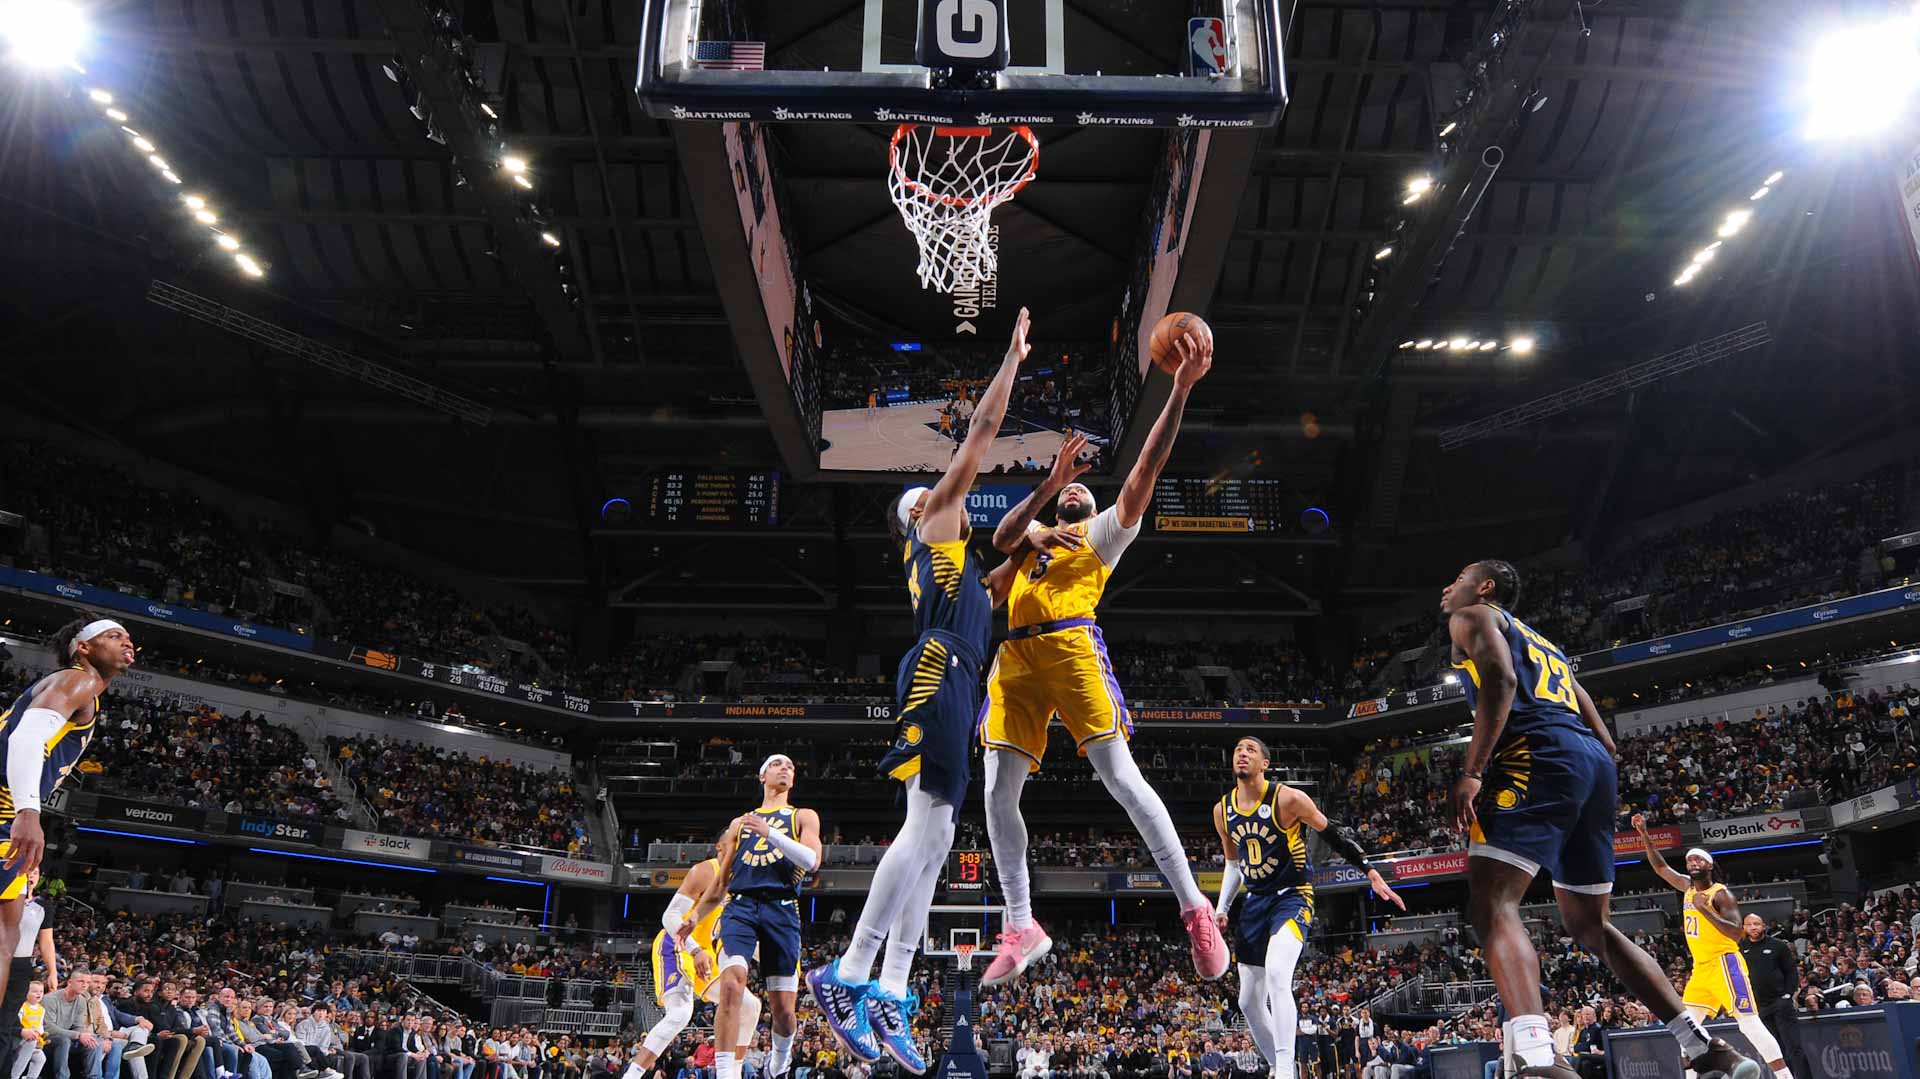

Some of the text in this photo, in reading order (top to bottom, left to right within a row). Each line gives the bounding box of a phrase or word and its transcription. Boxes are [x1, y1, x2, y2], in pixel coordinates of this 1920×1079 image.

[671, 105, 751, 119] DRAFTKINGS
[772, 107, 852, 120] DRAFTKINGS
[873, 108, 953, 124] DRAFTKINGS
[976, 112, 1054, 125] DRAFTKINGS
[1077, 112, 1154, 125] DRAFTKINGS
[1177, 113, 1254, 127] DRAFTKINGS
[963, 488, 1007, 509] rona
[421, 668, 434, 679] 45
[450, 675, 462, 685] 29
[1528, 643, 1581, 714] 23
[527, 692, 543, 703] 5/6
[1406, 696, 1418, 705] 46
[1432, 690, 1443, 700] 27
[564, 700, 589, 713] 15/39
[726, 706, 805, 717] INDIANA PACERS
[865, 706, 890, 718] 106
[1140, 710, 1183, 720] ANGELES
[1185, 710, 1222, 720] LAKERS
[1294, 714, 1300, 723] 3
[124, 806, 173, 823] verizon
[1702, 821, 1766, 839] KeyBank
[378, 837, 411, 851] slack
[959, 852, 981, 864] 3:03
[1245, 837, 1262, 866] 0
[551, 858, 604, 879] Bally SPORTS
[961, 864, 978, 882] 13
[1396, 863, 1425, 874] STEAK
[1432, 858, 1465, 870] SHAKE
[1685, 915, 1700, 938] 21
[1619, 1056, 1660, 1079] Corona
[1821, 1044, 1894, 1078] Corona
